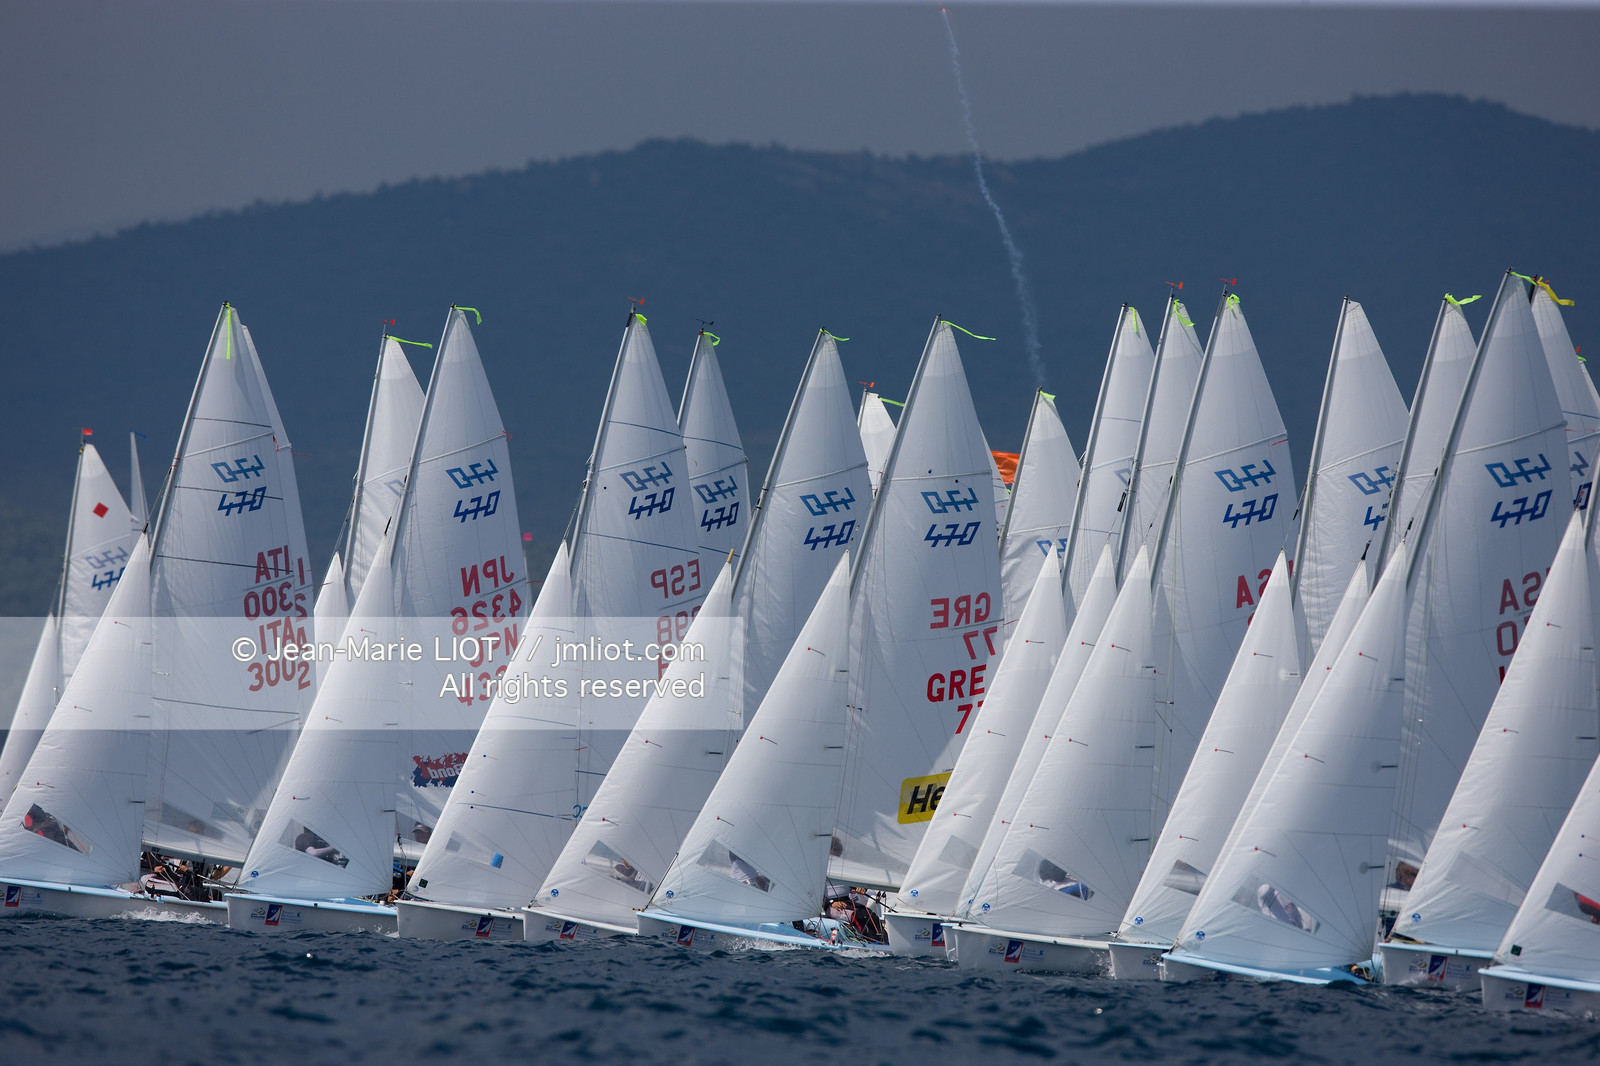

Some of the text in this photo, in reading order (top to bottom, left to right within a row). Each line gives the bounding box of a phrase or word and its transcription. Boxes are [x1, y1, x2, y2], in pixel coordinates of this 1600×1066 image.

[217, 485, 268, 517] 470
[452, 489, 501, 523] 470
[628, 485, 676, 520] 470
[700, 500, 741, 533] 470
[1222, 492, 1279, 529] 470
[1489, 488, 1553, 529] 470
[803, 519, 856, 551] 470
[924, 520, 981, 548] 470
[926, 664, 987, 704] GRE
